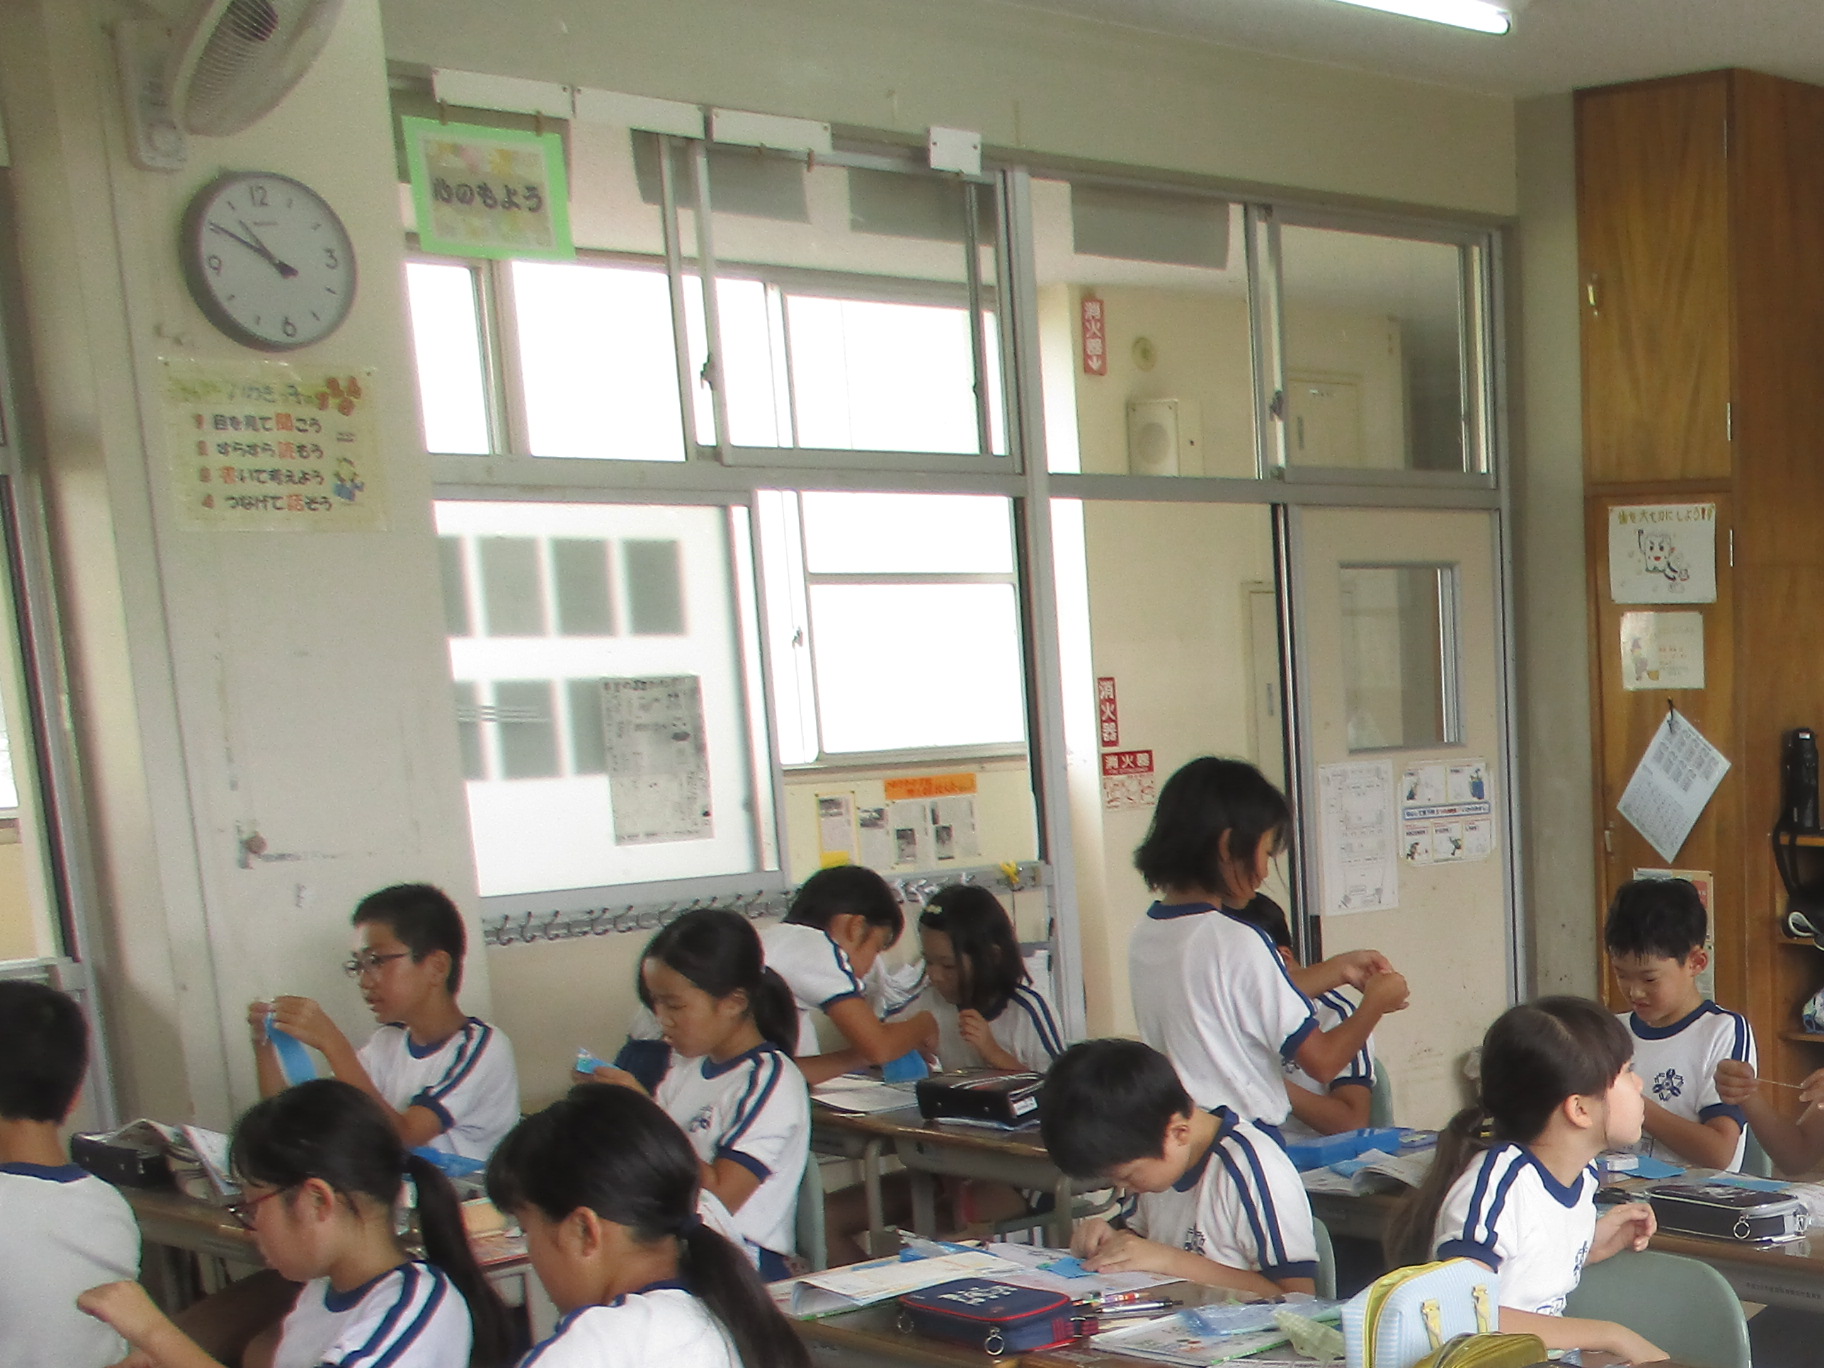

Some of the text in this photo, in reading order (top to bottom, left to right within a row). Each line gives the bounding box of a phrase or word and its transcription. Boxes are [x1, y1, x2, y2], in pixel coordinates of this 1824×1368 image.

[249, 185, 269, 208] 12
[208, 254, 222, 277] 9
[324, 248, 339, 270] 3
[281, 316, 297, 338] 6
[1084, 301, 1103, 355] 消火器
[1099, 680, 1118, 742] 消火器
[1104, 752, 1151, 769] 消火器
